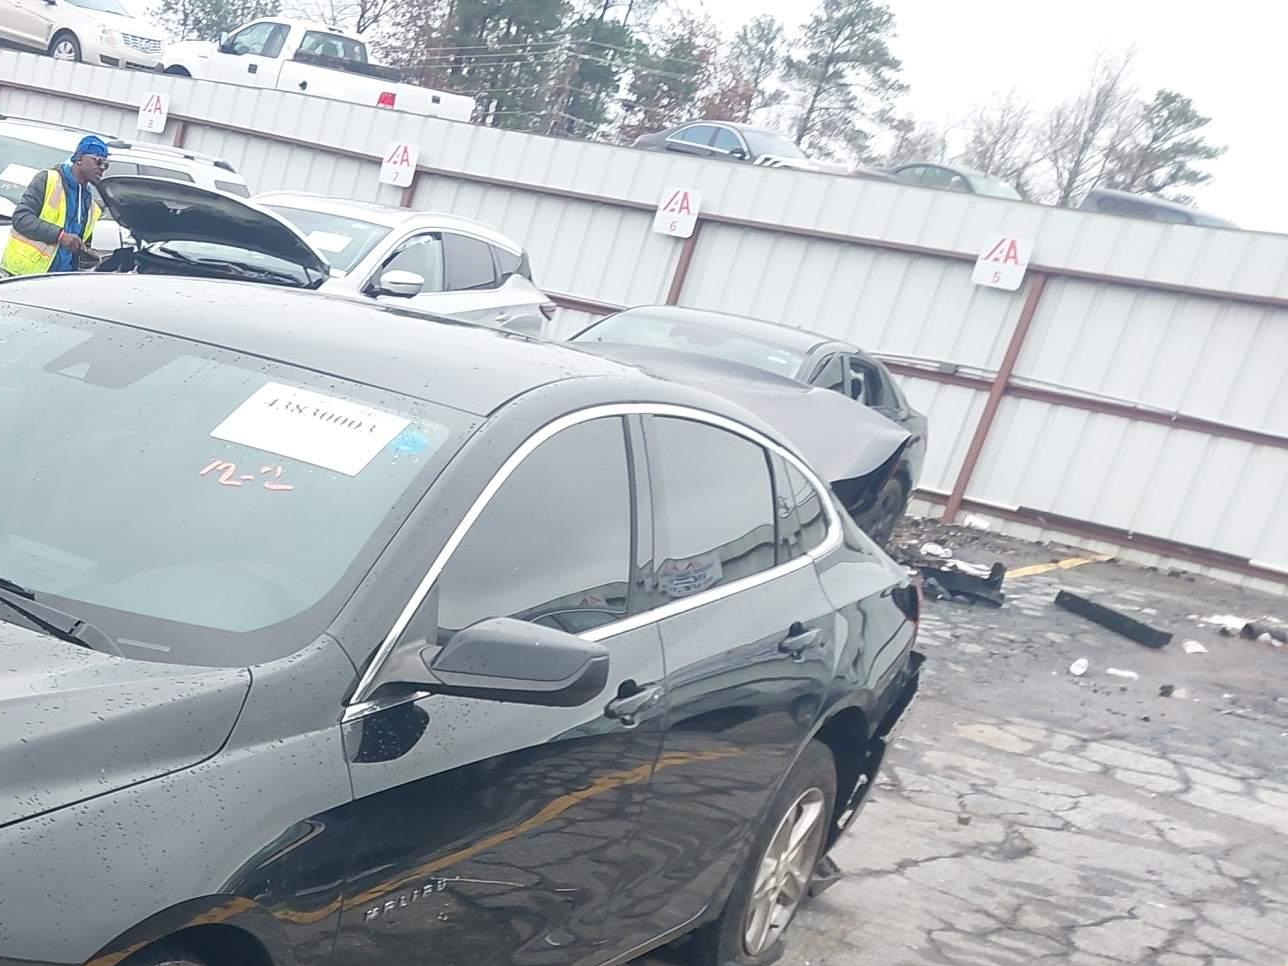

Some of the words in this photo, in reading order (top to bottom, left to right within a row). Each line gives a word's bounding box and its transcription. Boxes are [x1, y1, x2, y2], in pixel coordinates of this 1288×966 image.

[392, 171, 400, 182] 7
[669, 220, 678, 232] 6
[992, 271, 1001, 284] 5
